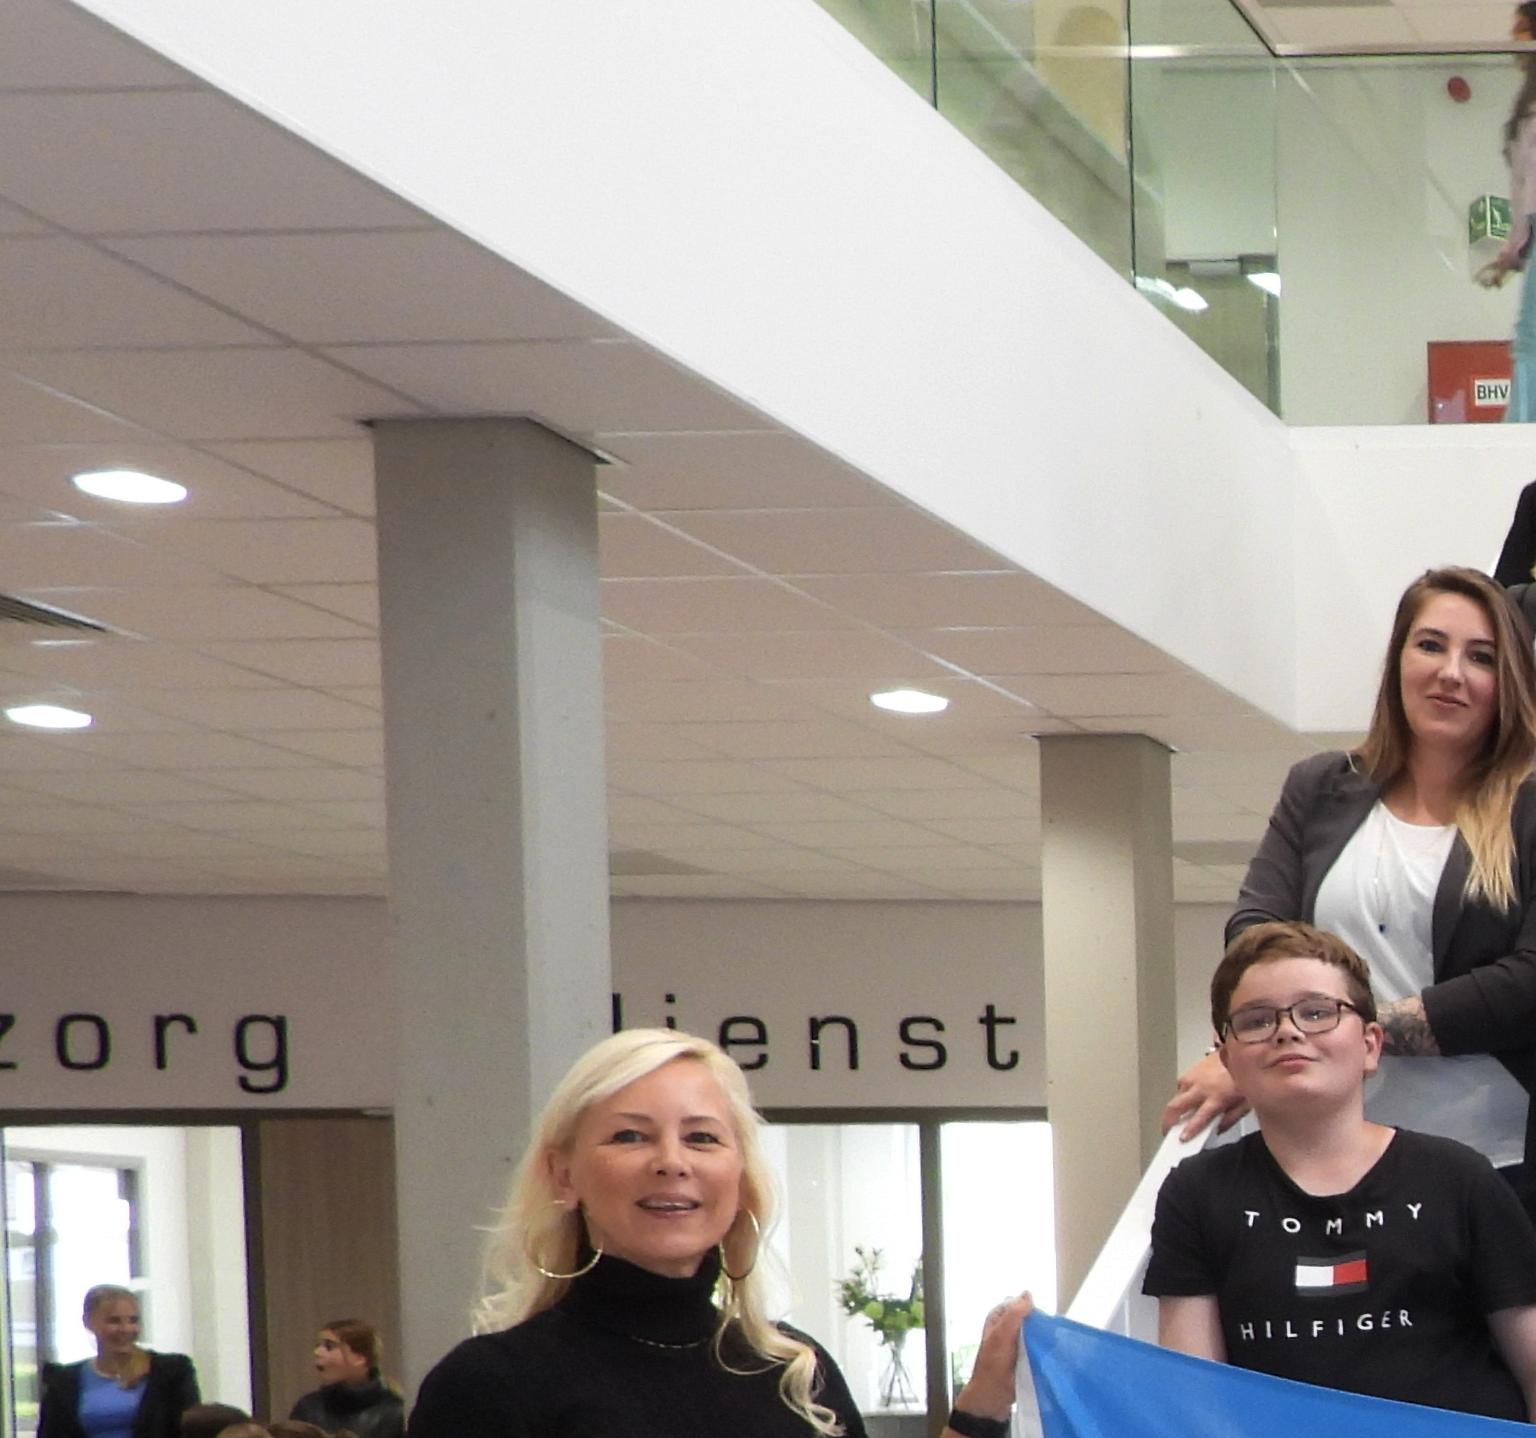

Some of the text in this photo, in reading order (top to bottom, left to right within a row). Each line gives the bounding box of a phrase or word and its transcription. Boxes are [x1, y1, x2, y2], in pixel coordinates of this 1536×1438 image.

[1477, 384, 1509, 400] BHV
[612, 992, 1020, 1071] enst
[1244, 1203, 1422, 1236] TOMMY
[1240, 1309, 1413, 1341] HILFIGER
